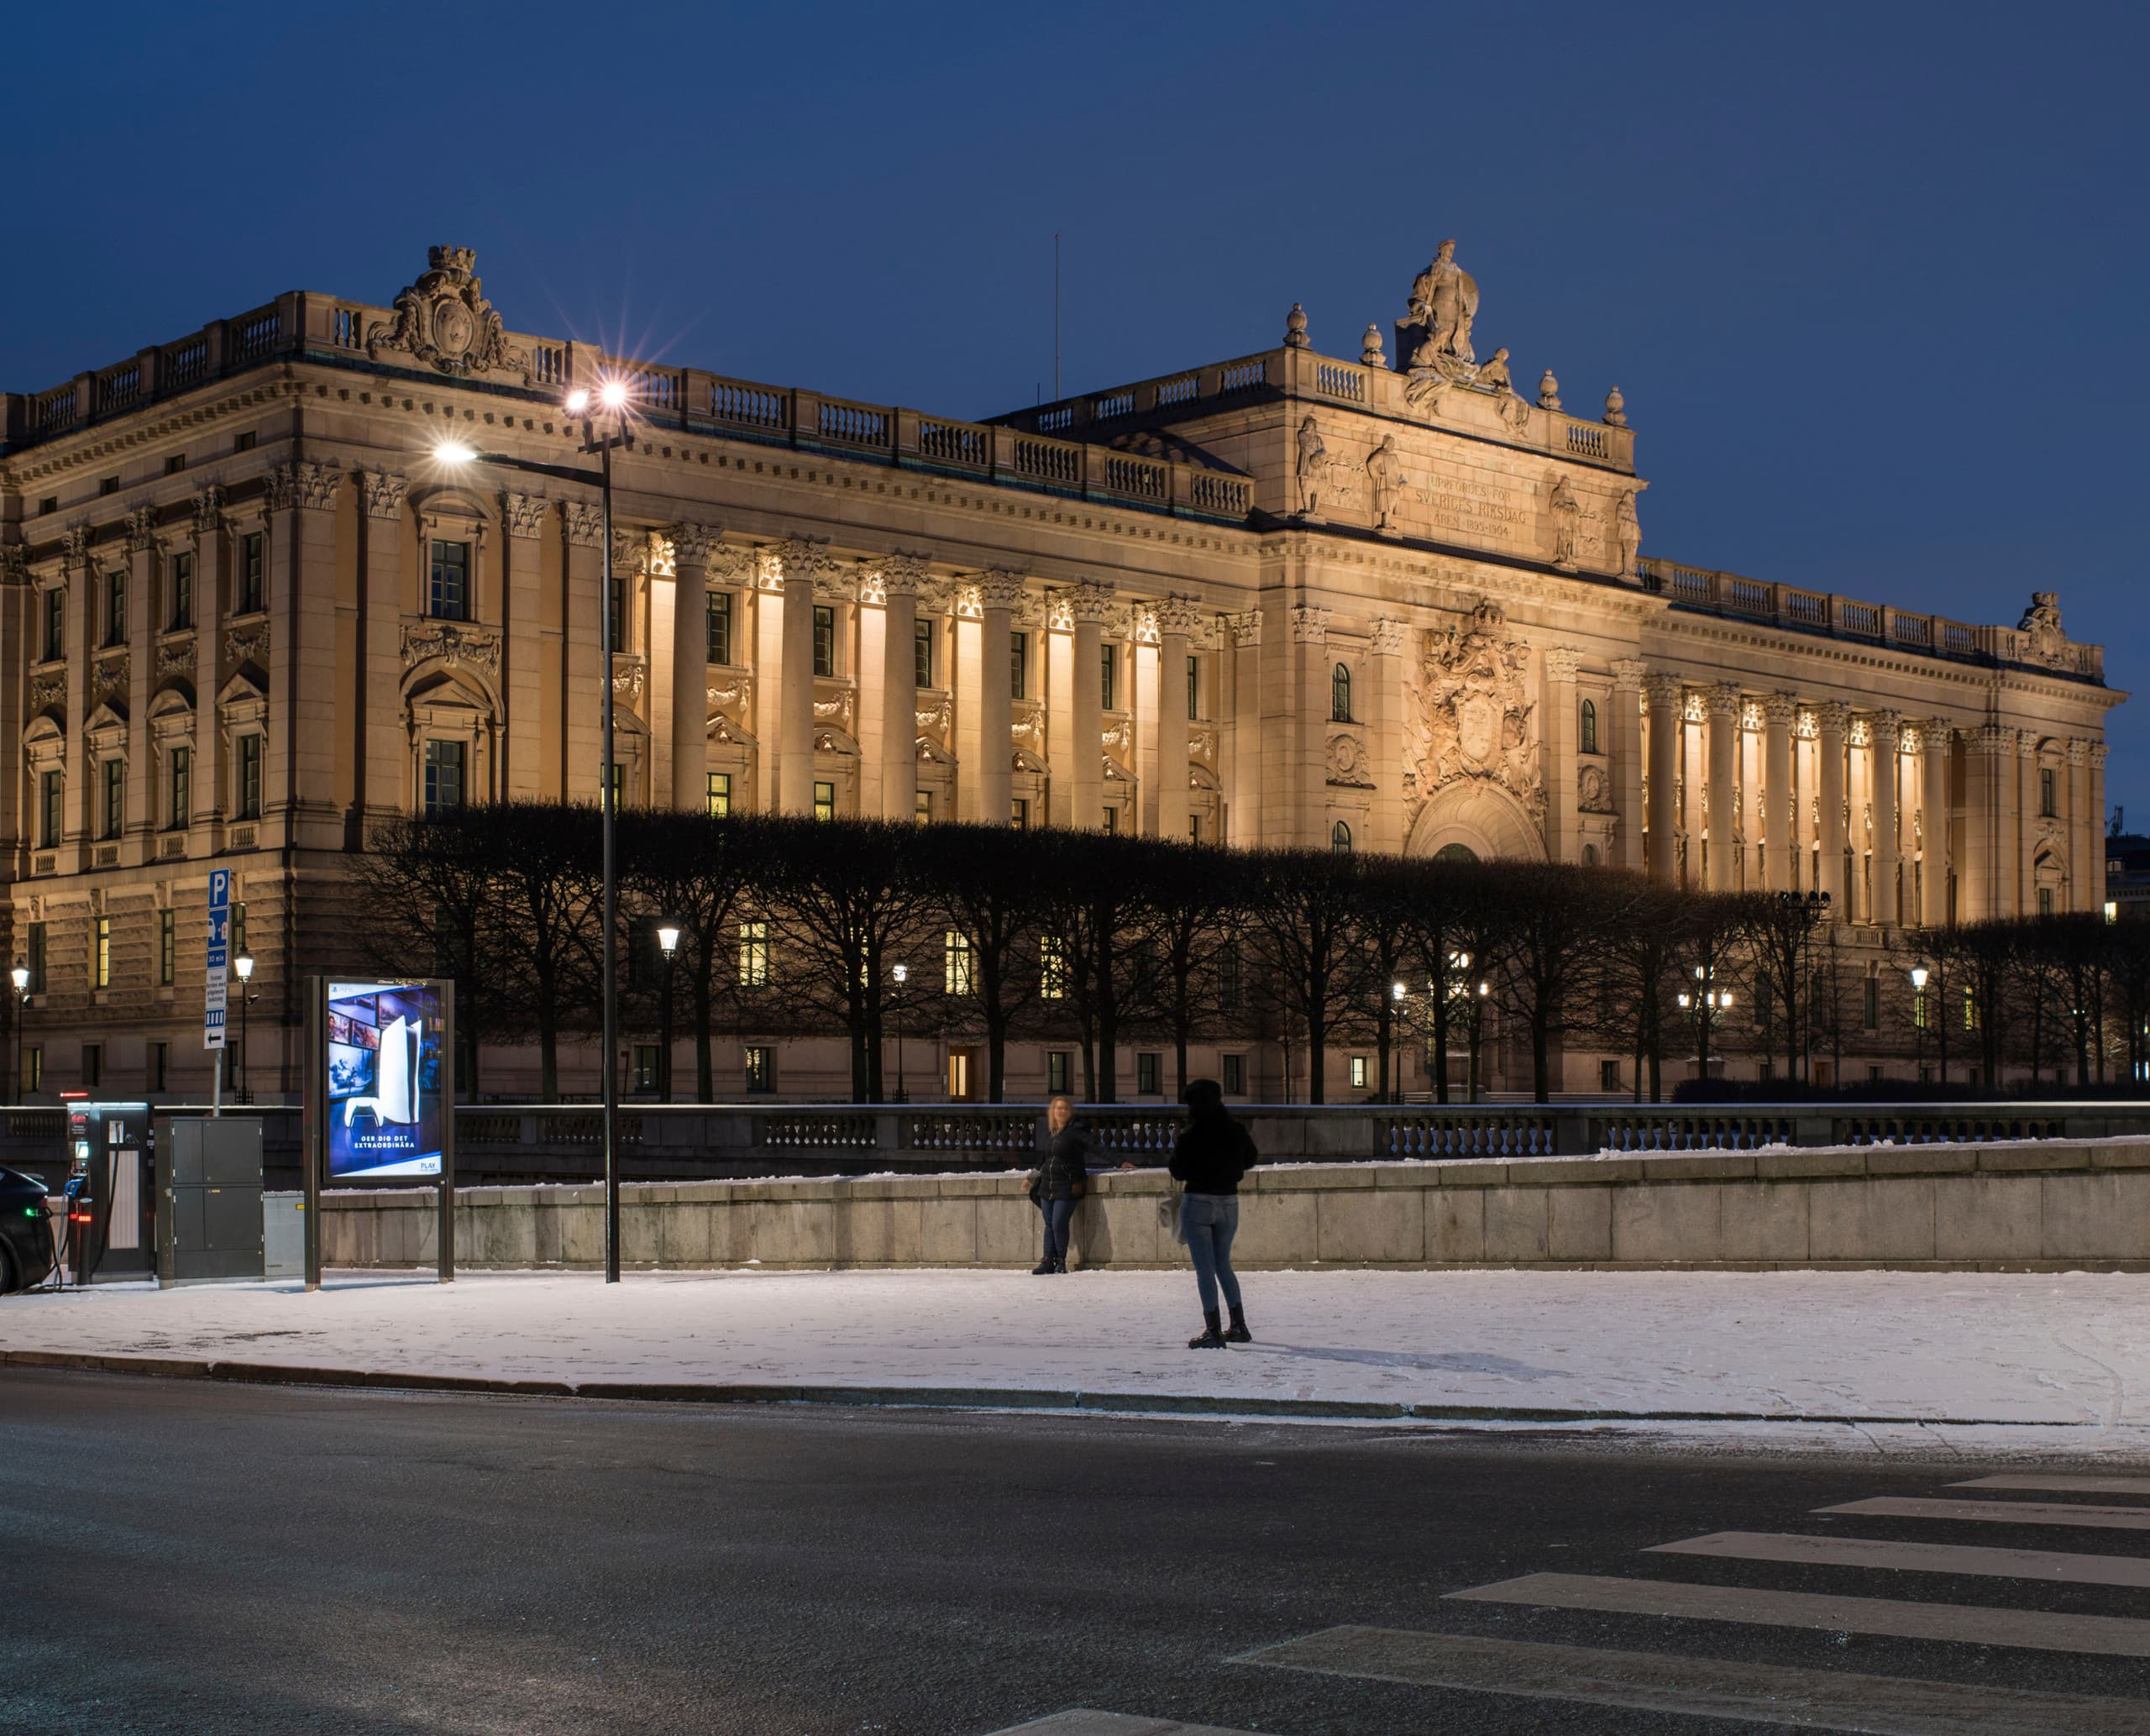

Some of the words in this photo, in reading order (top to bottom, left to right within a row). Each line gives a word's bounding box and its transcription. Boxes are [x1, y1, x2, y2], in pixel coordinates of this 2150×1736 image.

[1416, 490, 1473, 513] SVERIGES
[1478, 501, 1526, 524] RIKSDAG
[213, 873, 226, 905] P
